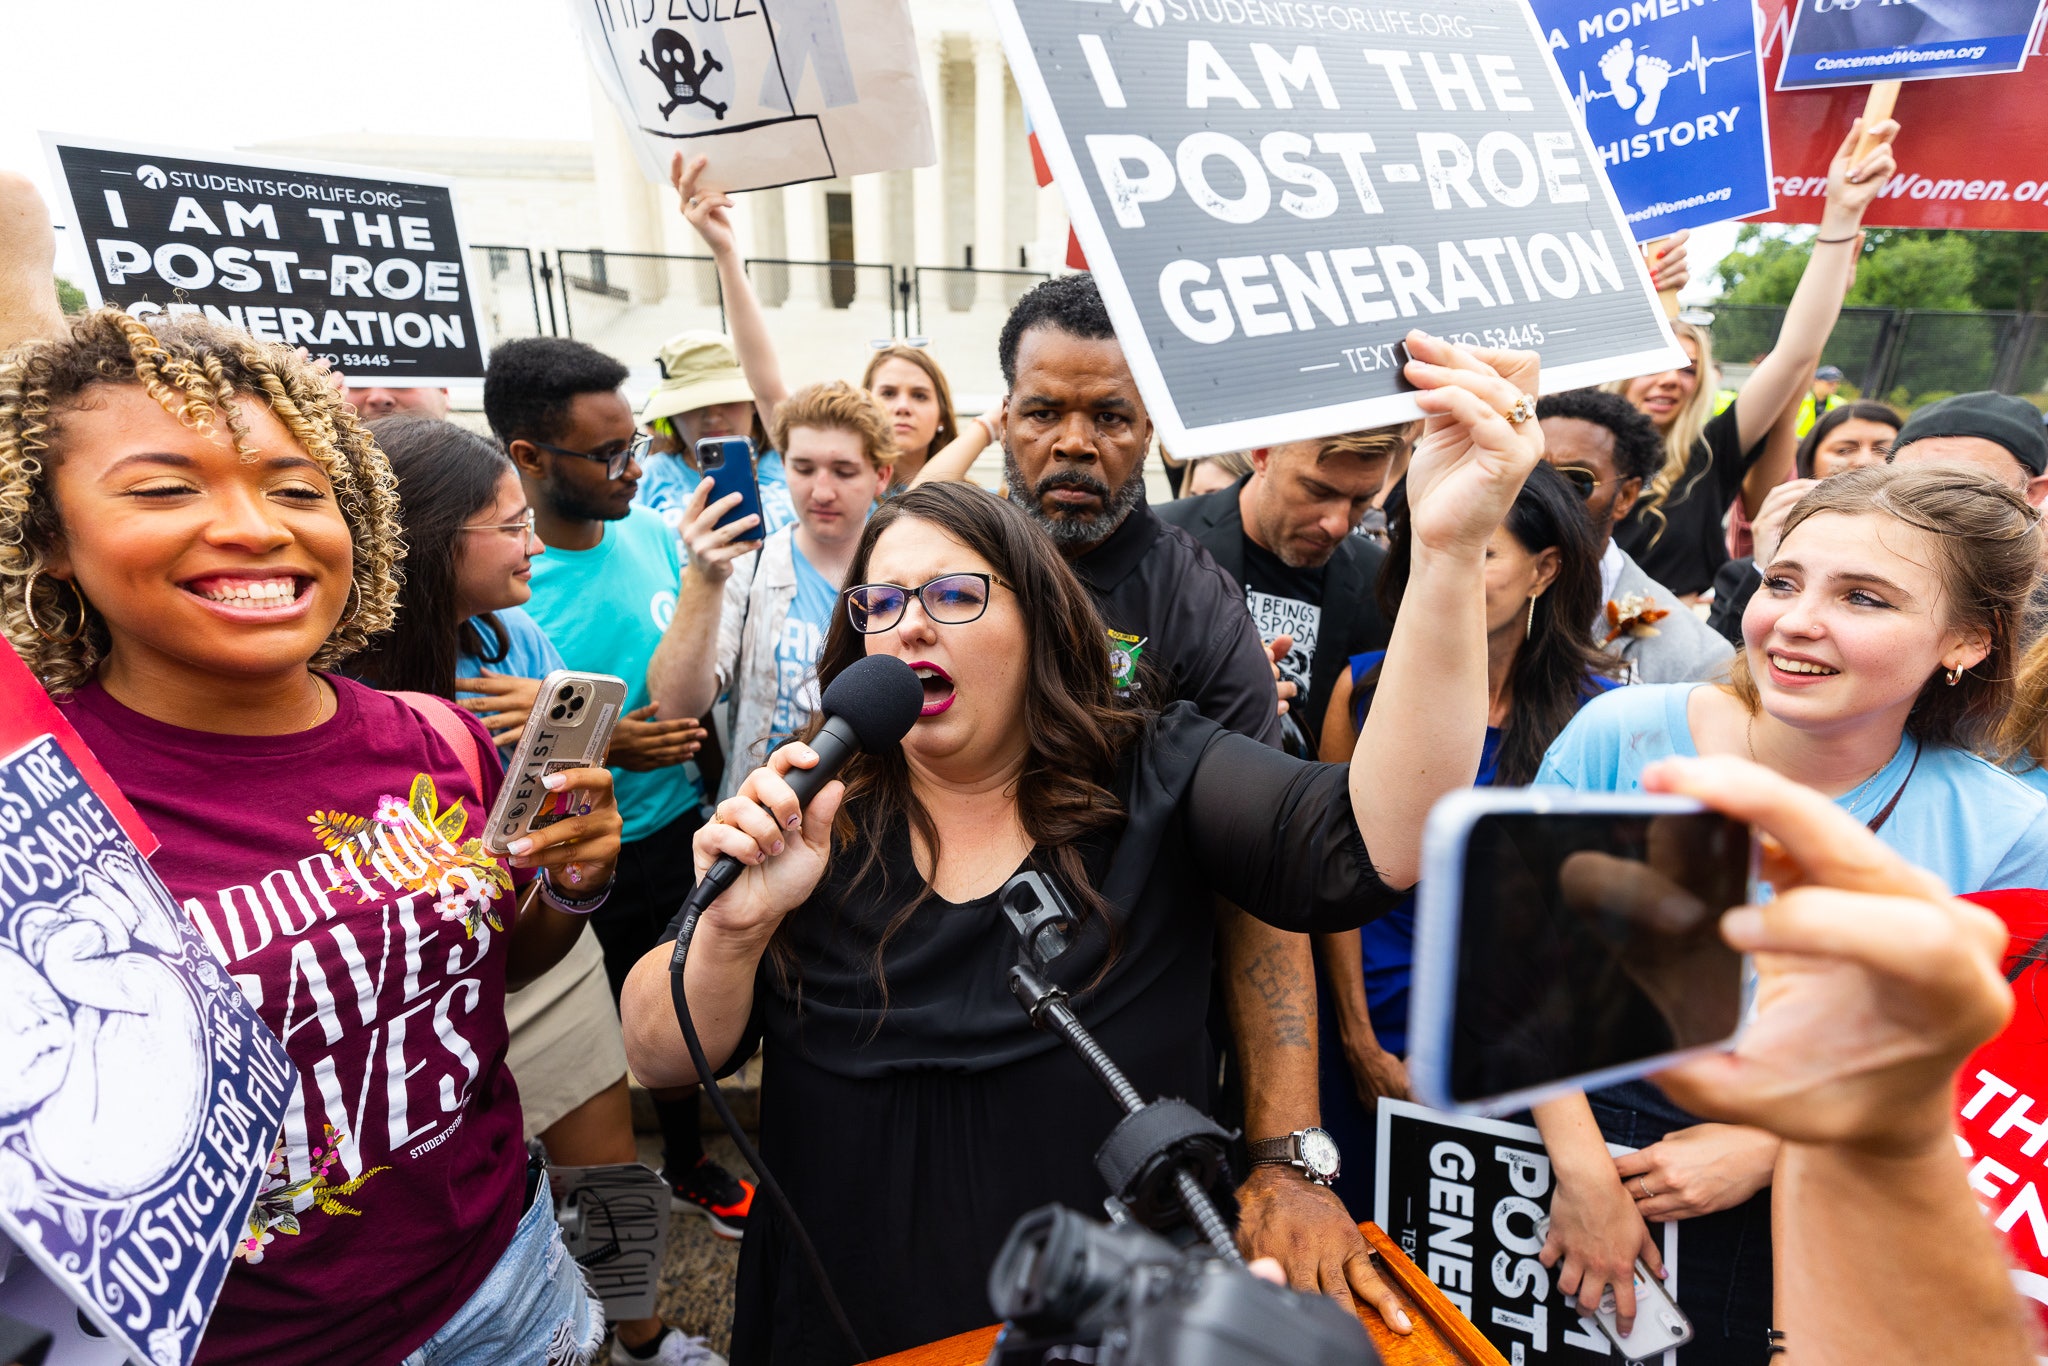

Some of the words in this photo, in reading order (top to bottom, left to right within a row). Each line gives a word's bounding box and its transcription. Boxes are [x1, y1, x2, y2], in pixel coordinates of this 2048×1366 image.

[1172, 0, 1474, 38] STUDENTSFORLIFE.ORG
[1549, 28, 1570, 50] A
[1078, 34, 1127, 109] I
[1186, 40, 1341, 110] AM
[1363, 49, 1534, 111] THE
[1814, 45, 1987, 71] ConcernedWomen.org
[1598, 106, 1741, 168] HISTORY
[170, 170, 403, 209] STUDENTSFORLIFE.ORG
[1085, 131, 1590, 229] POST-ROE
[1625, 187, 1732, 224] nedWomen.org
[103, 189, 128, 228] I
[169, 197, 281, 240] AM
[308, 208, 436, 252] THE
[97, 237, 461, 303] POST-ROE
[1158, 229, 1624, 345] GENERATION
[342, 353, 391, 367] 53445
[1341, 342, 1399, 374] TEXT
[1483, 323, 1545, 350] 53445
[1259, 615, 1316, 645] SPOSA
[1262, 597, 1315, 623] BEINGS
[16, 741, 79, 809] ARE
[0, 792, 118, 908] OSABLE
[234, 866, 490, 1049] AVES
[213, 1003, 242, 1075] THE
[243, 978, 482, 1236] IVES
[247, 1020, 290, 1128] FIVE
[205, 1077, 257, 1174] FOR
[1960, 1069, 2048, 1166] TH
[109, 1151, 225, 1332] JUSTICE
[1401, 1228, 1417, 1263] TEX
